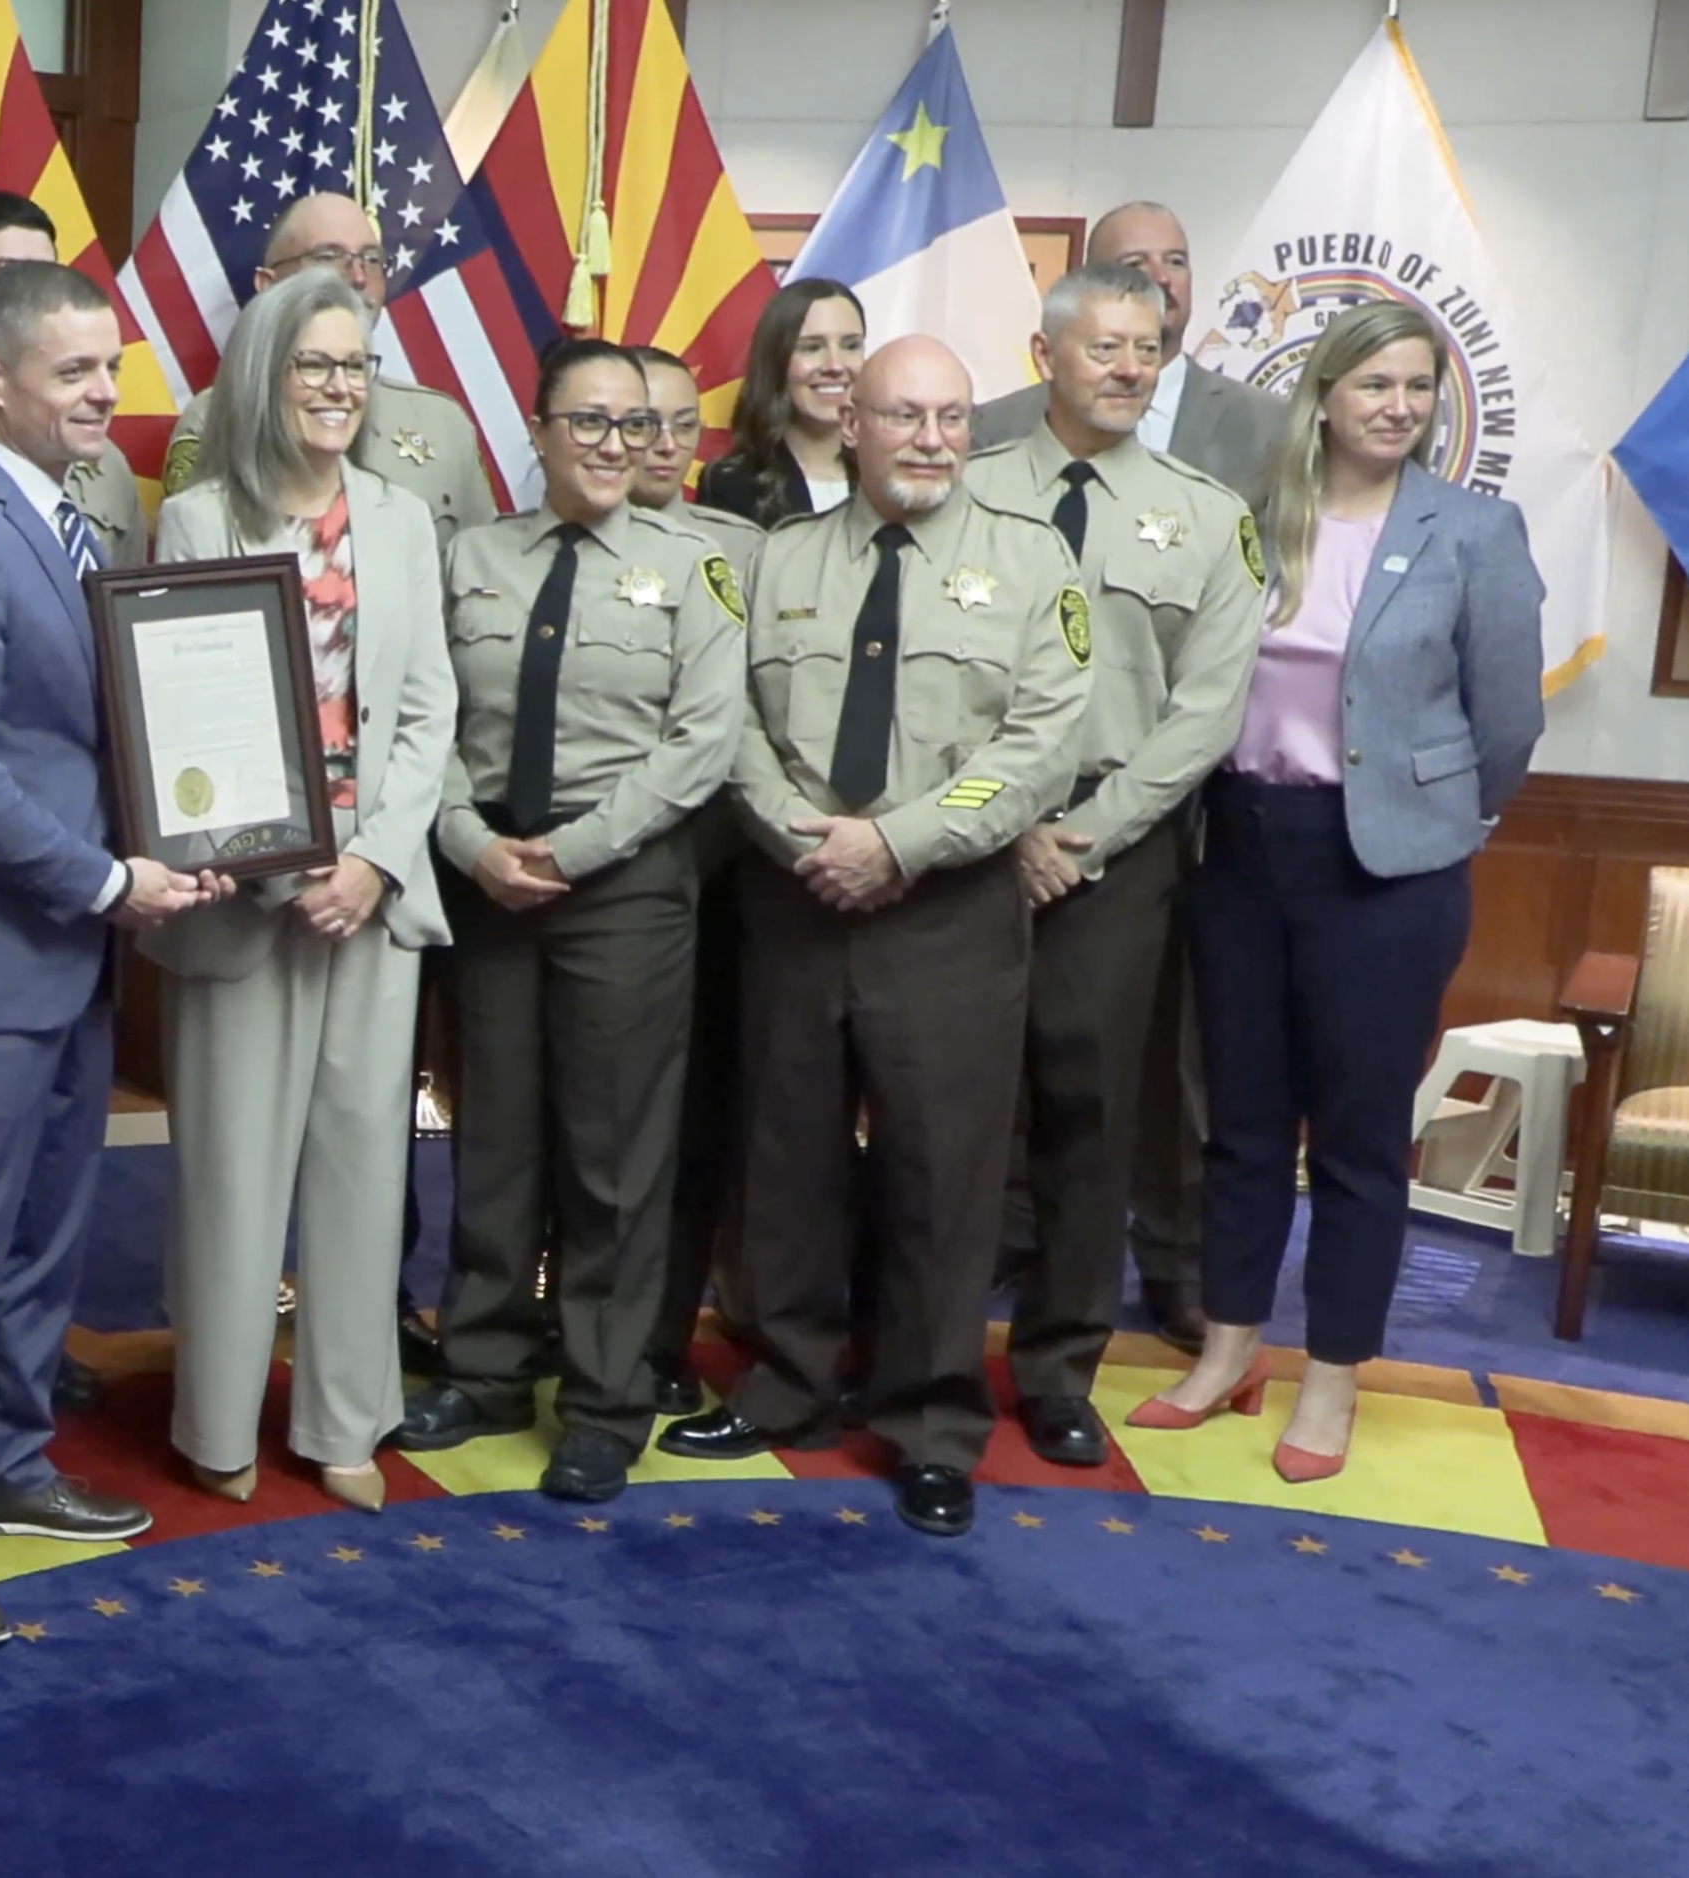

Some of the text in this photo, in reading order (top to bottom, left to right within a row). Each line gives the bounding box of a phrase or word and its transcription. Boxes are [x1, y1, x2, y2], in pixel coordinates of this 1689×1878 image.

[1274, 233, 1393, 273] PUEBLO
[1396, 253, 1441, 291] OF
[1436, 285, 1500, 360] ZUNI
[1476, 363, 1515, 438] NEW
[1468, 449, 1512, 498] ME
